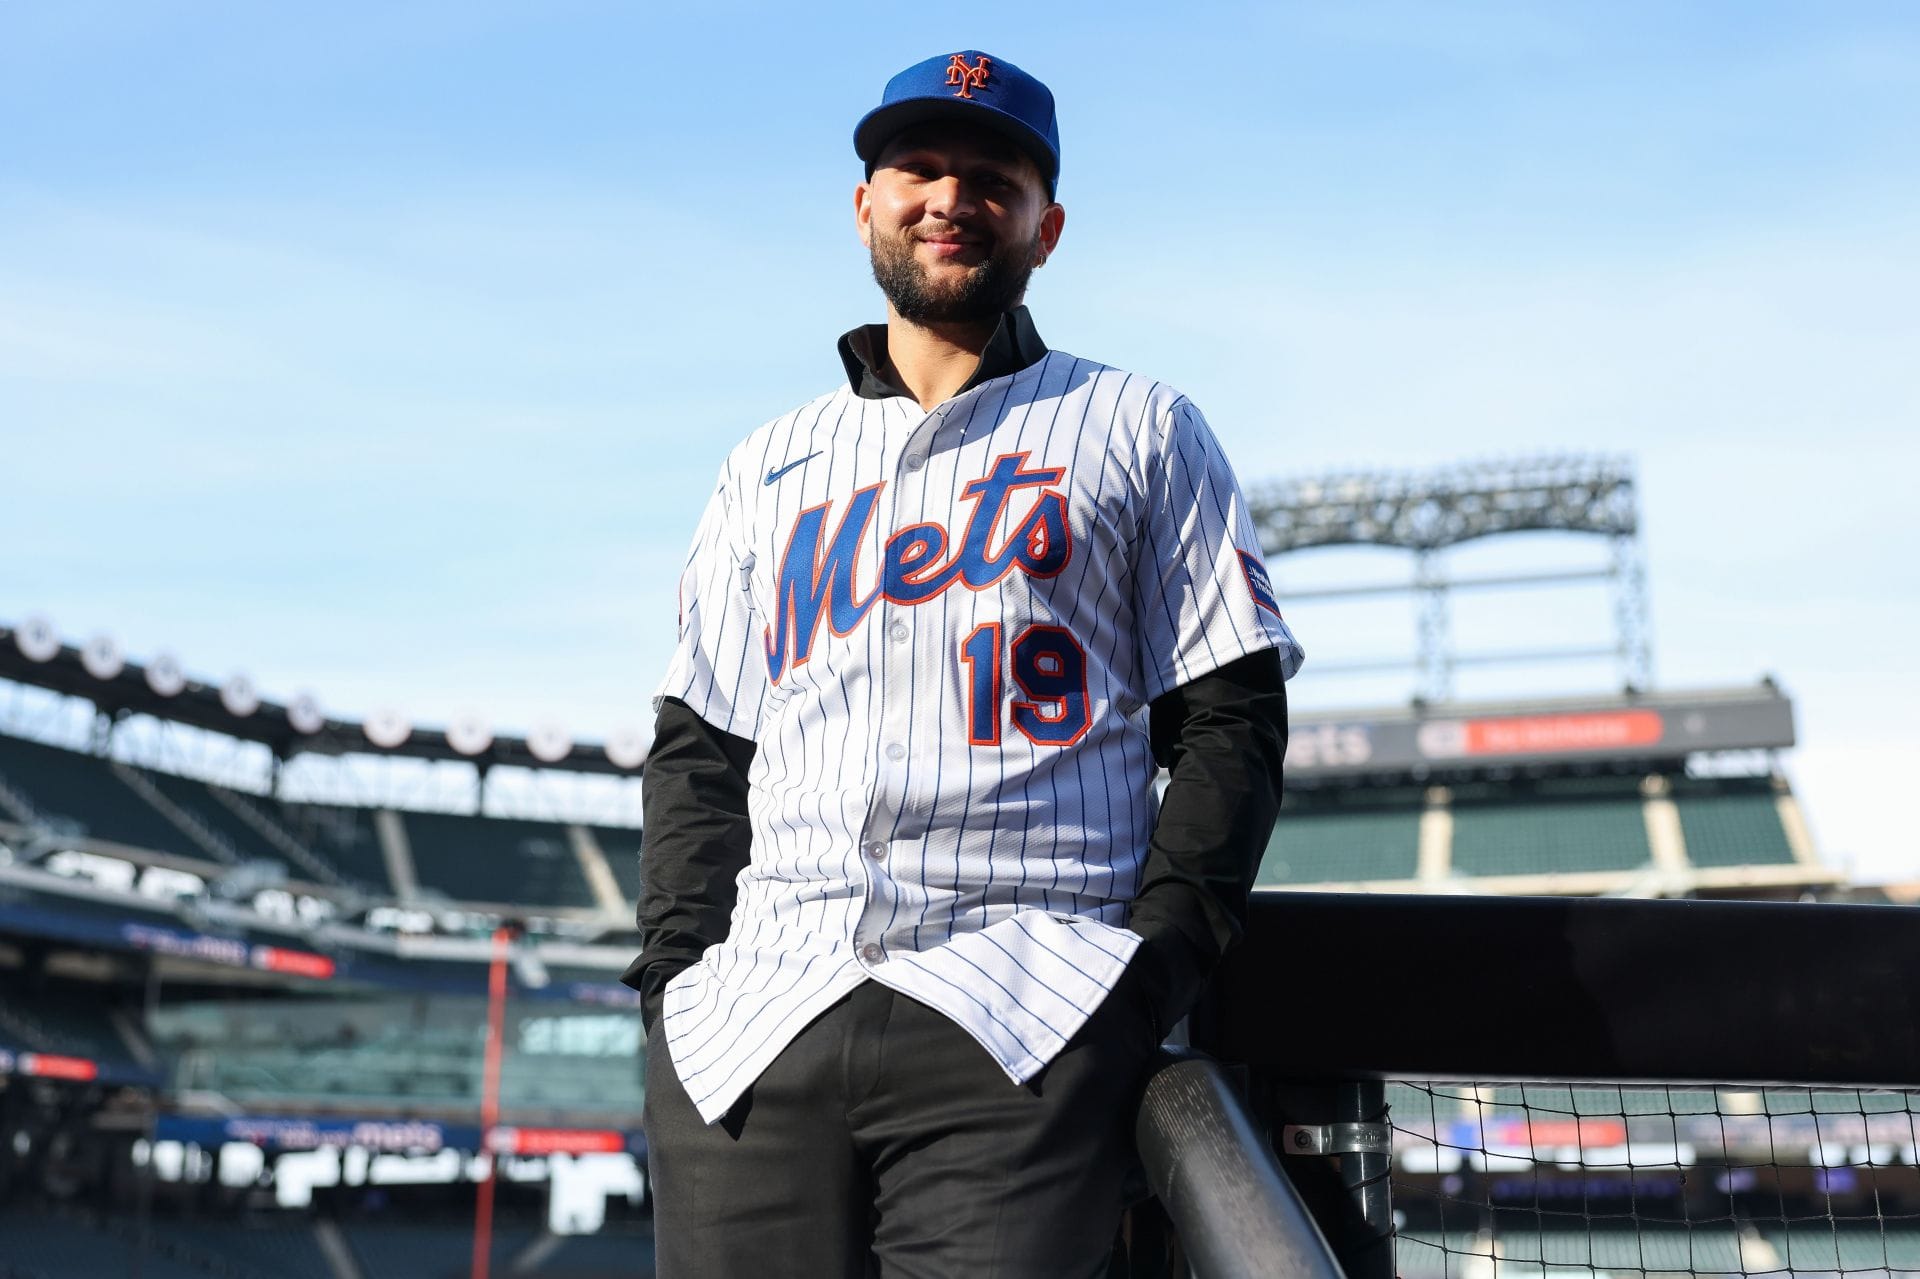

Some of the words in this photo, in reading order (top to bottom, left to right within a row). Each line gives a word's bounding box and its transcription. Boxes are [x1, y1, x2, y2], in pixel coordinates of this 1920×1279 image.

[944, 53, 992, 99] NY
[763, 450, 1073, 687] Mets
[961, 621, 1092, 747] 19
